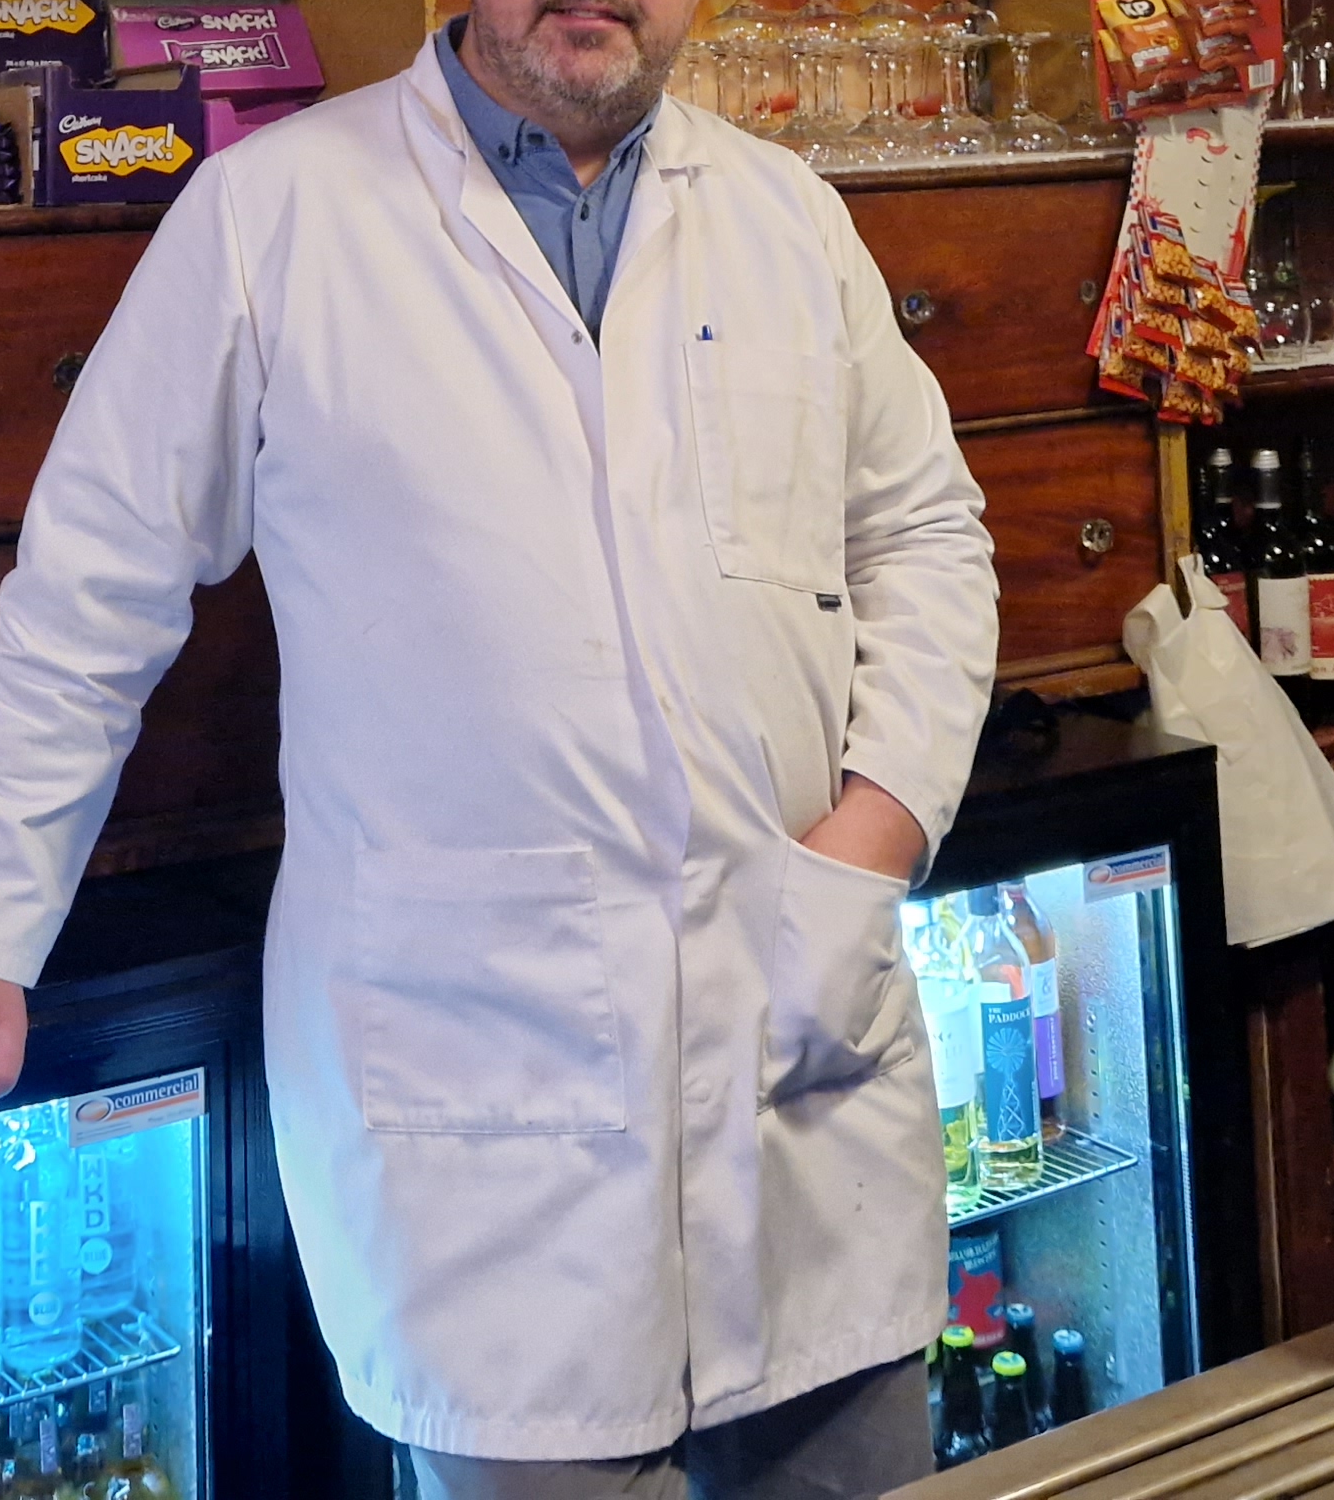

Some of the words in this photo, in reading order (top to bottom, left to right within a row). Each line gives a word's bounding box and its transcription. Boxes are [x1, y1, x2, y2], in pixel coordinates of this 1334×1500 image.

[200, 9, 278, 33] SNACK!
[1120, 0, 1153, 17] KP
[200, 39, 270, 65] SNACK!
[58, 114, 102, 134] Cadbury
[75, 123, 175, 167] SNACK!
[113, 1074, 199, 1110] commercial
